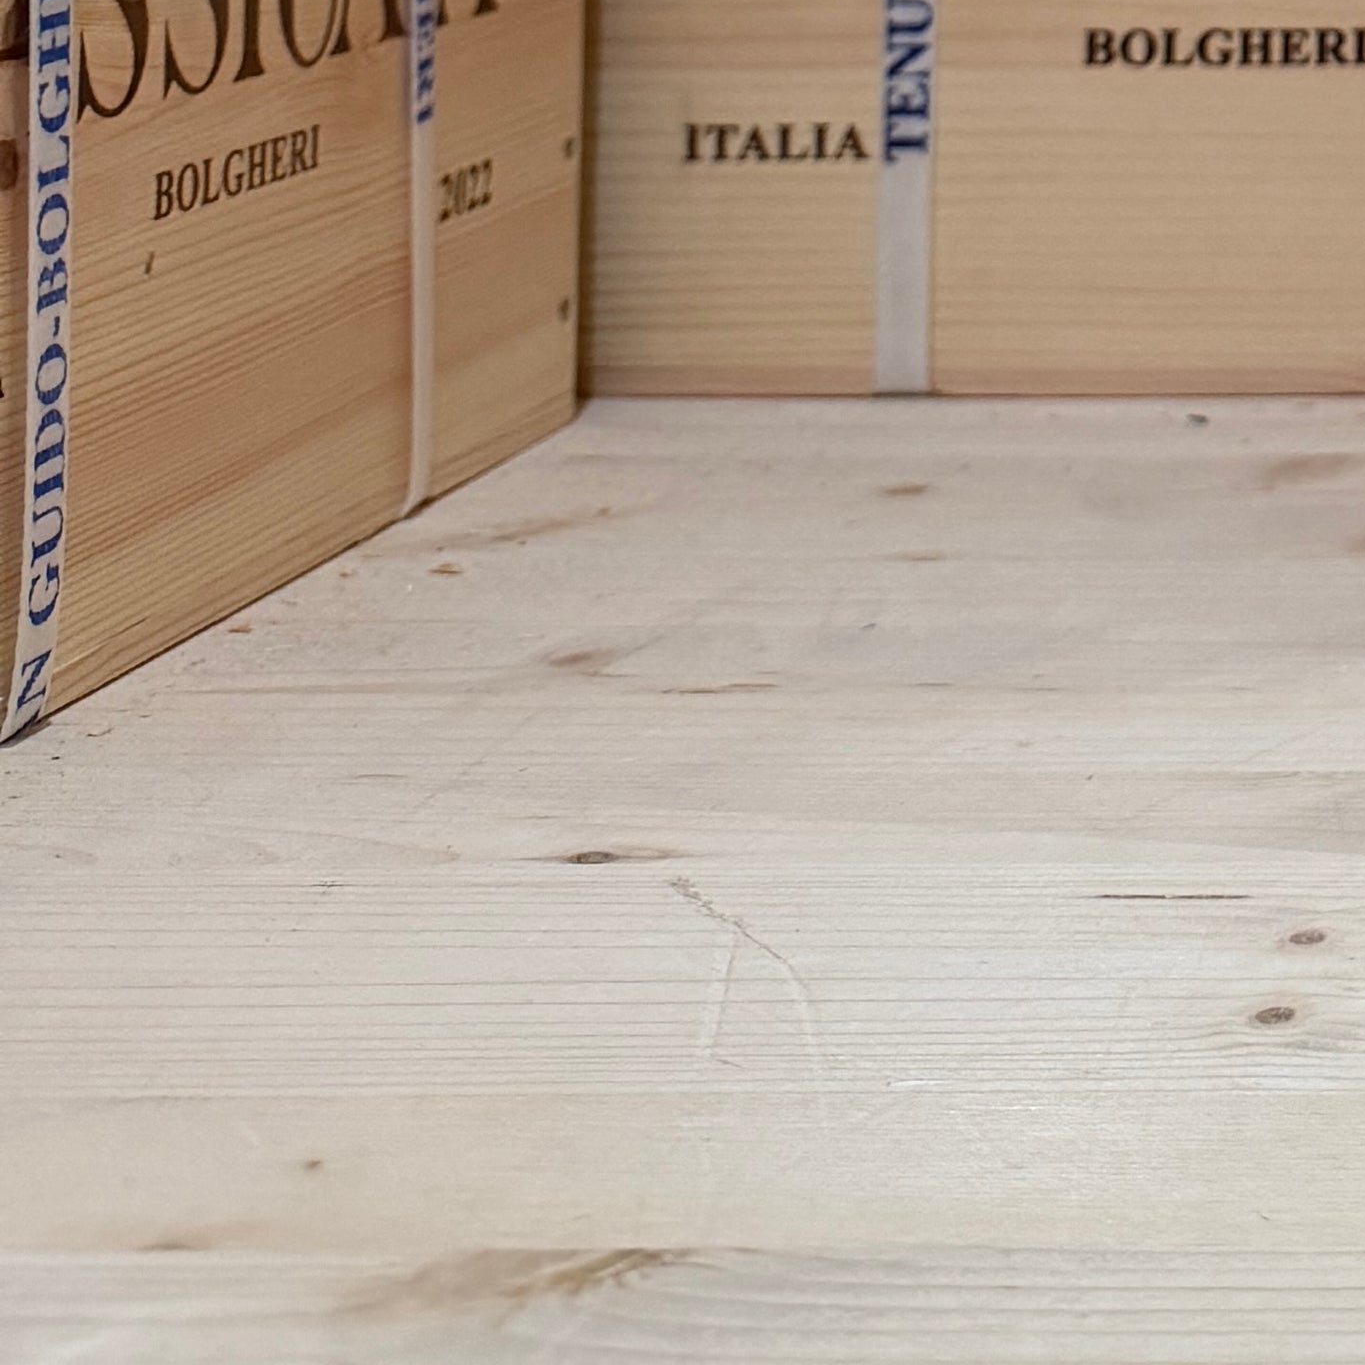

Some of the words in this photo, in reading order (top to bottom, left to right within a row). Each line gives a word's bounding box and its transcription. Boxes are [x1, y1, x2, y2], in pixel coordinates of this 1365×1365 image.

[151, 122, 320, 224] BOLGHERI
[683, 121, 868, 162] ITALIA
[438, 159, 493, 222] 2022
